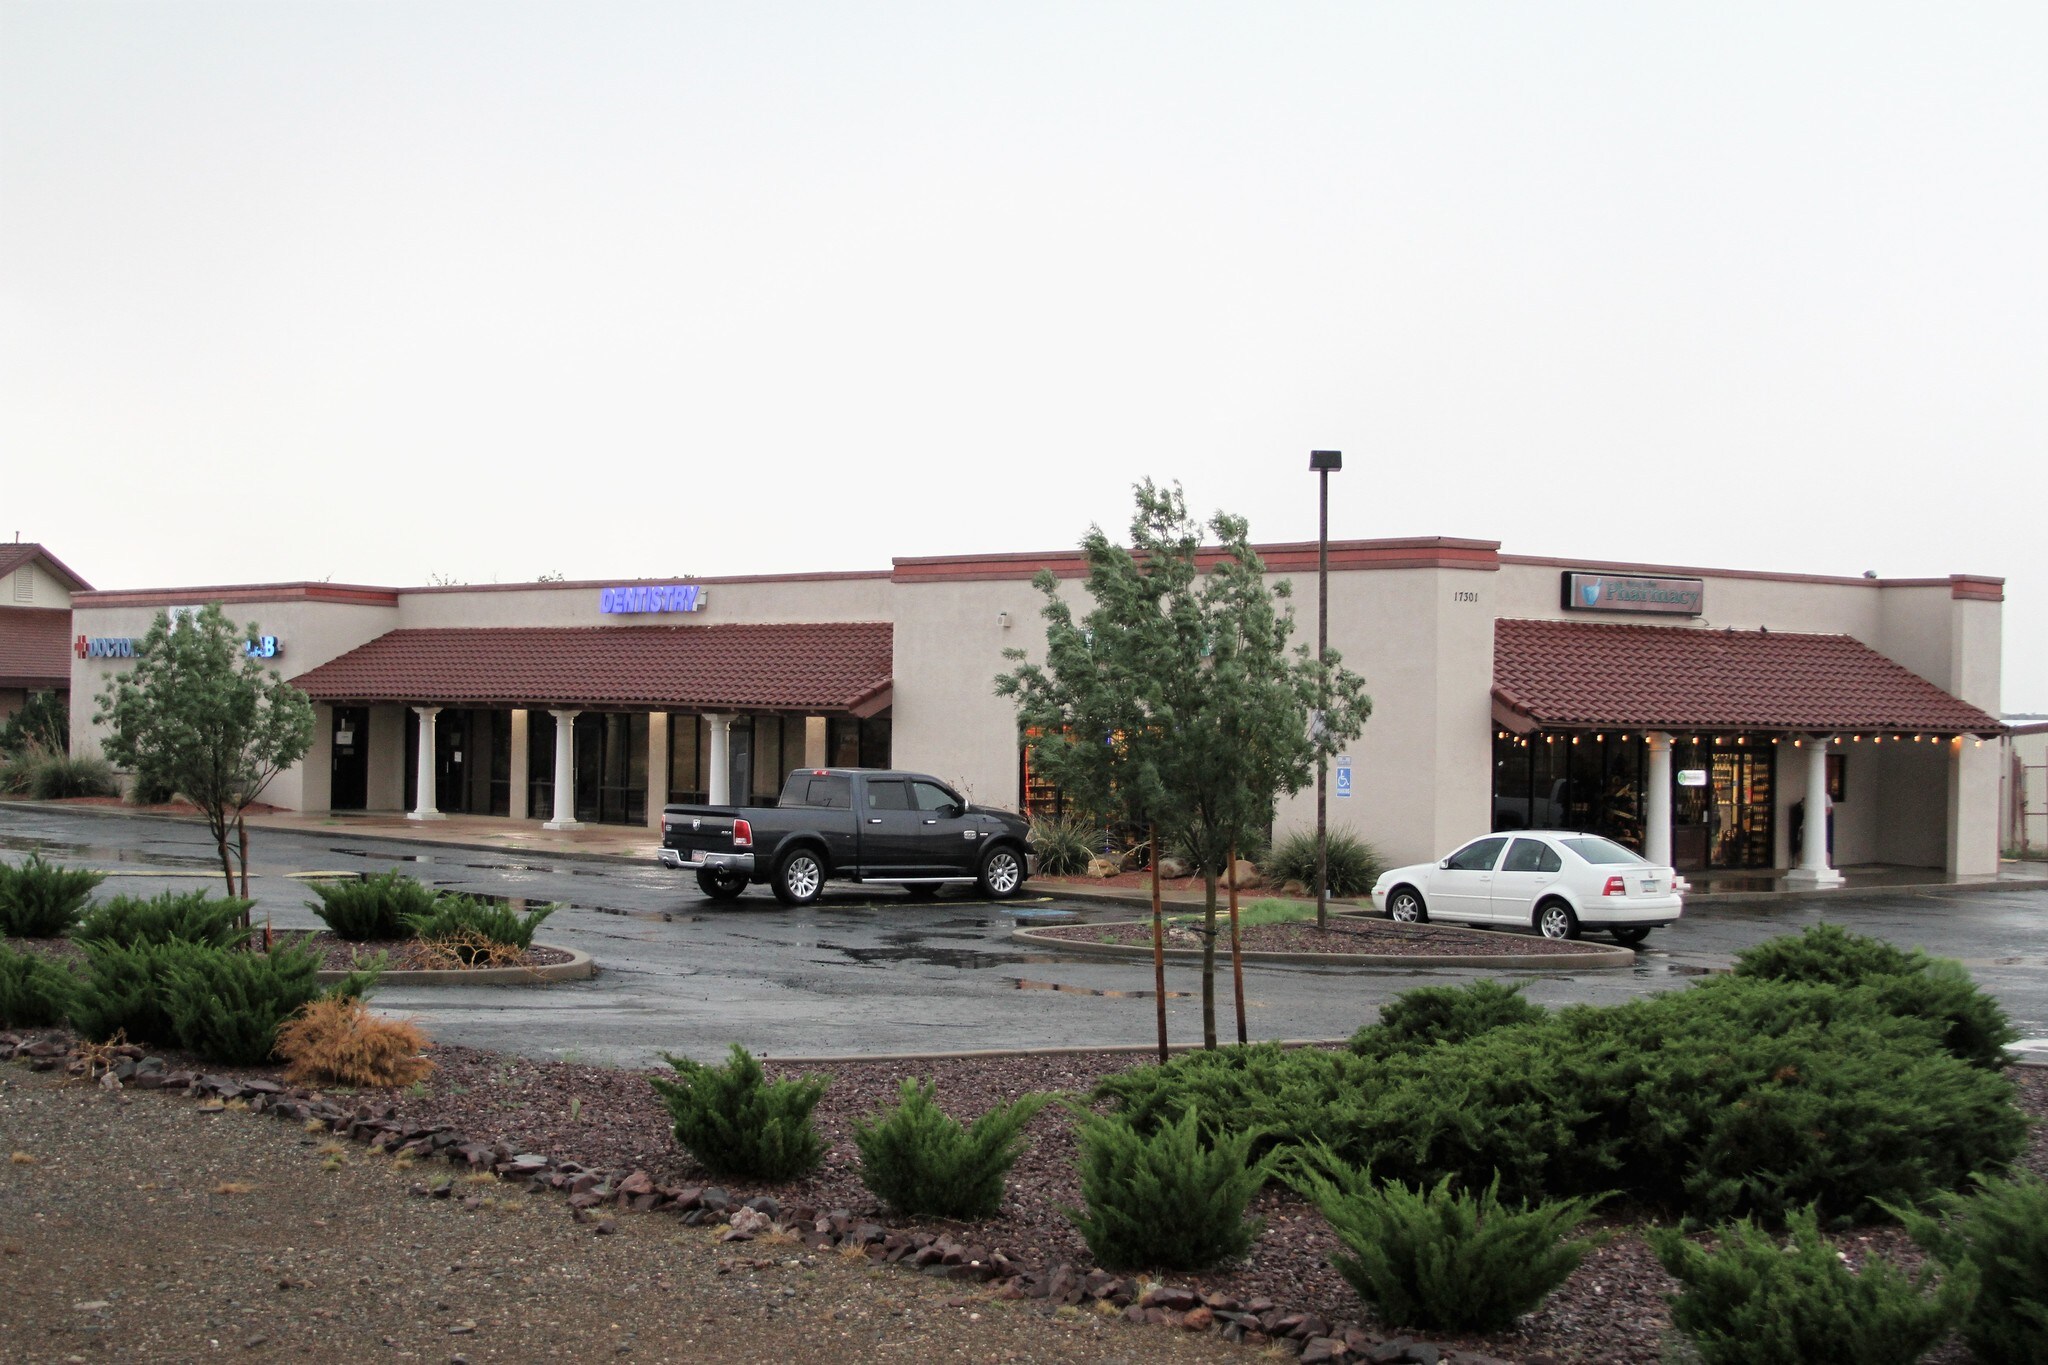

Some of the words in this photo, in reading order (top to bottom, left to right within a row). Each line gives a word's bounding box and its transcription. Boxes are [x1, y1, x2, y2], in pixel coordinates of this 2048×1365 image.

[600, 585, 699, 613] DENTISTRY
[1454, 591, 1478, 602] 17301
[1606, 581, 1699, 610] Pharmacy
[88, 637, 143, 657] DOCTO
